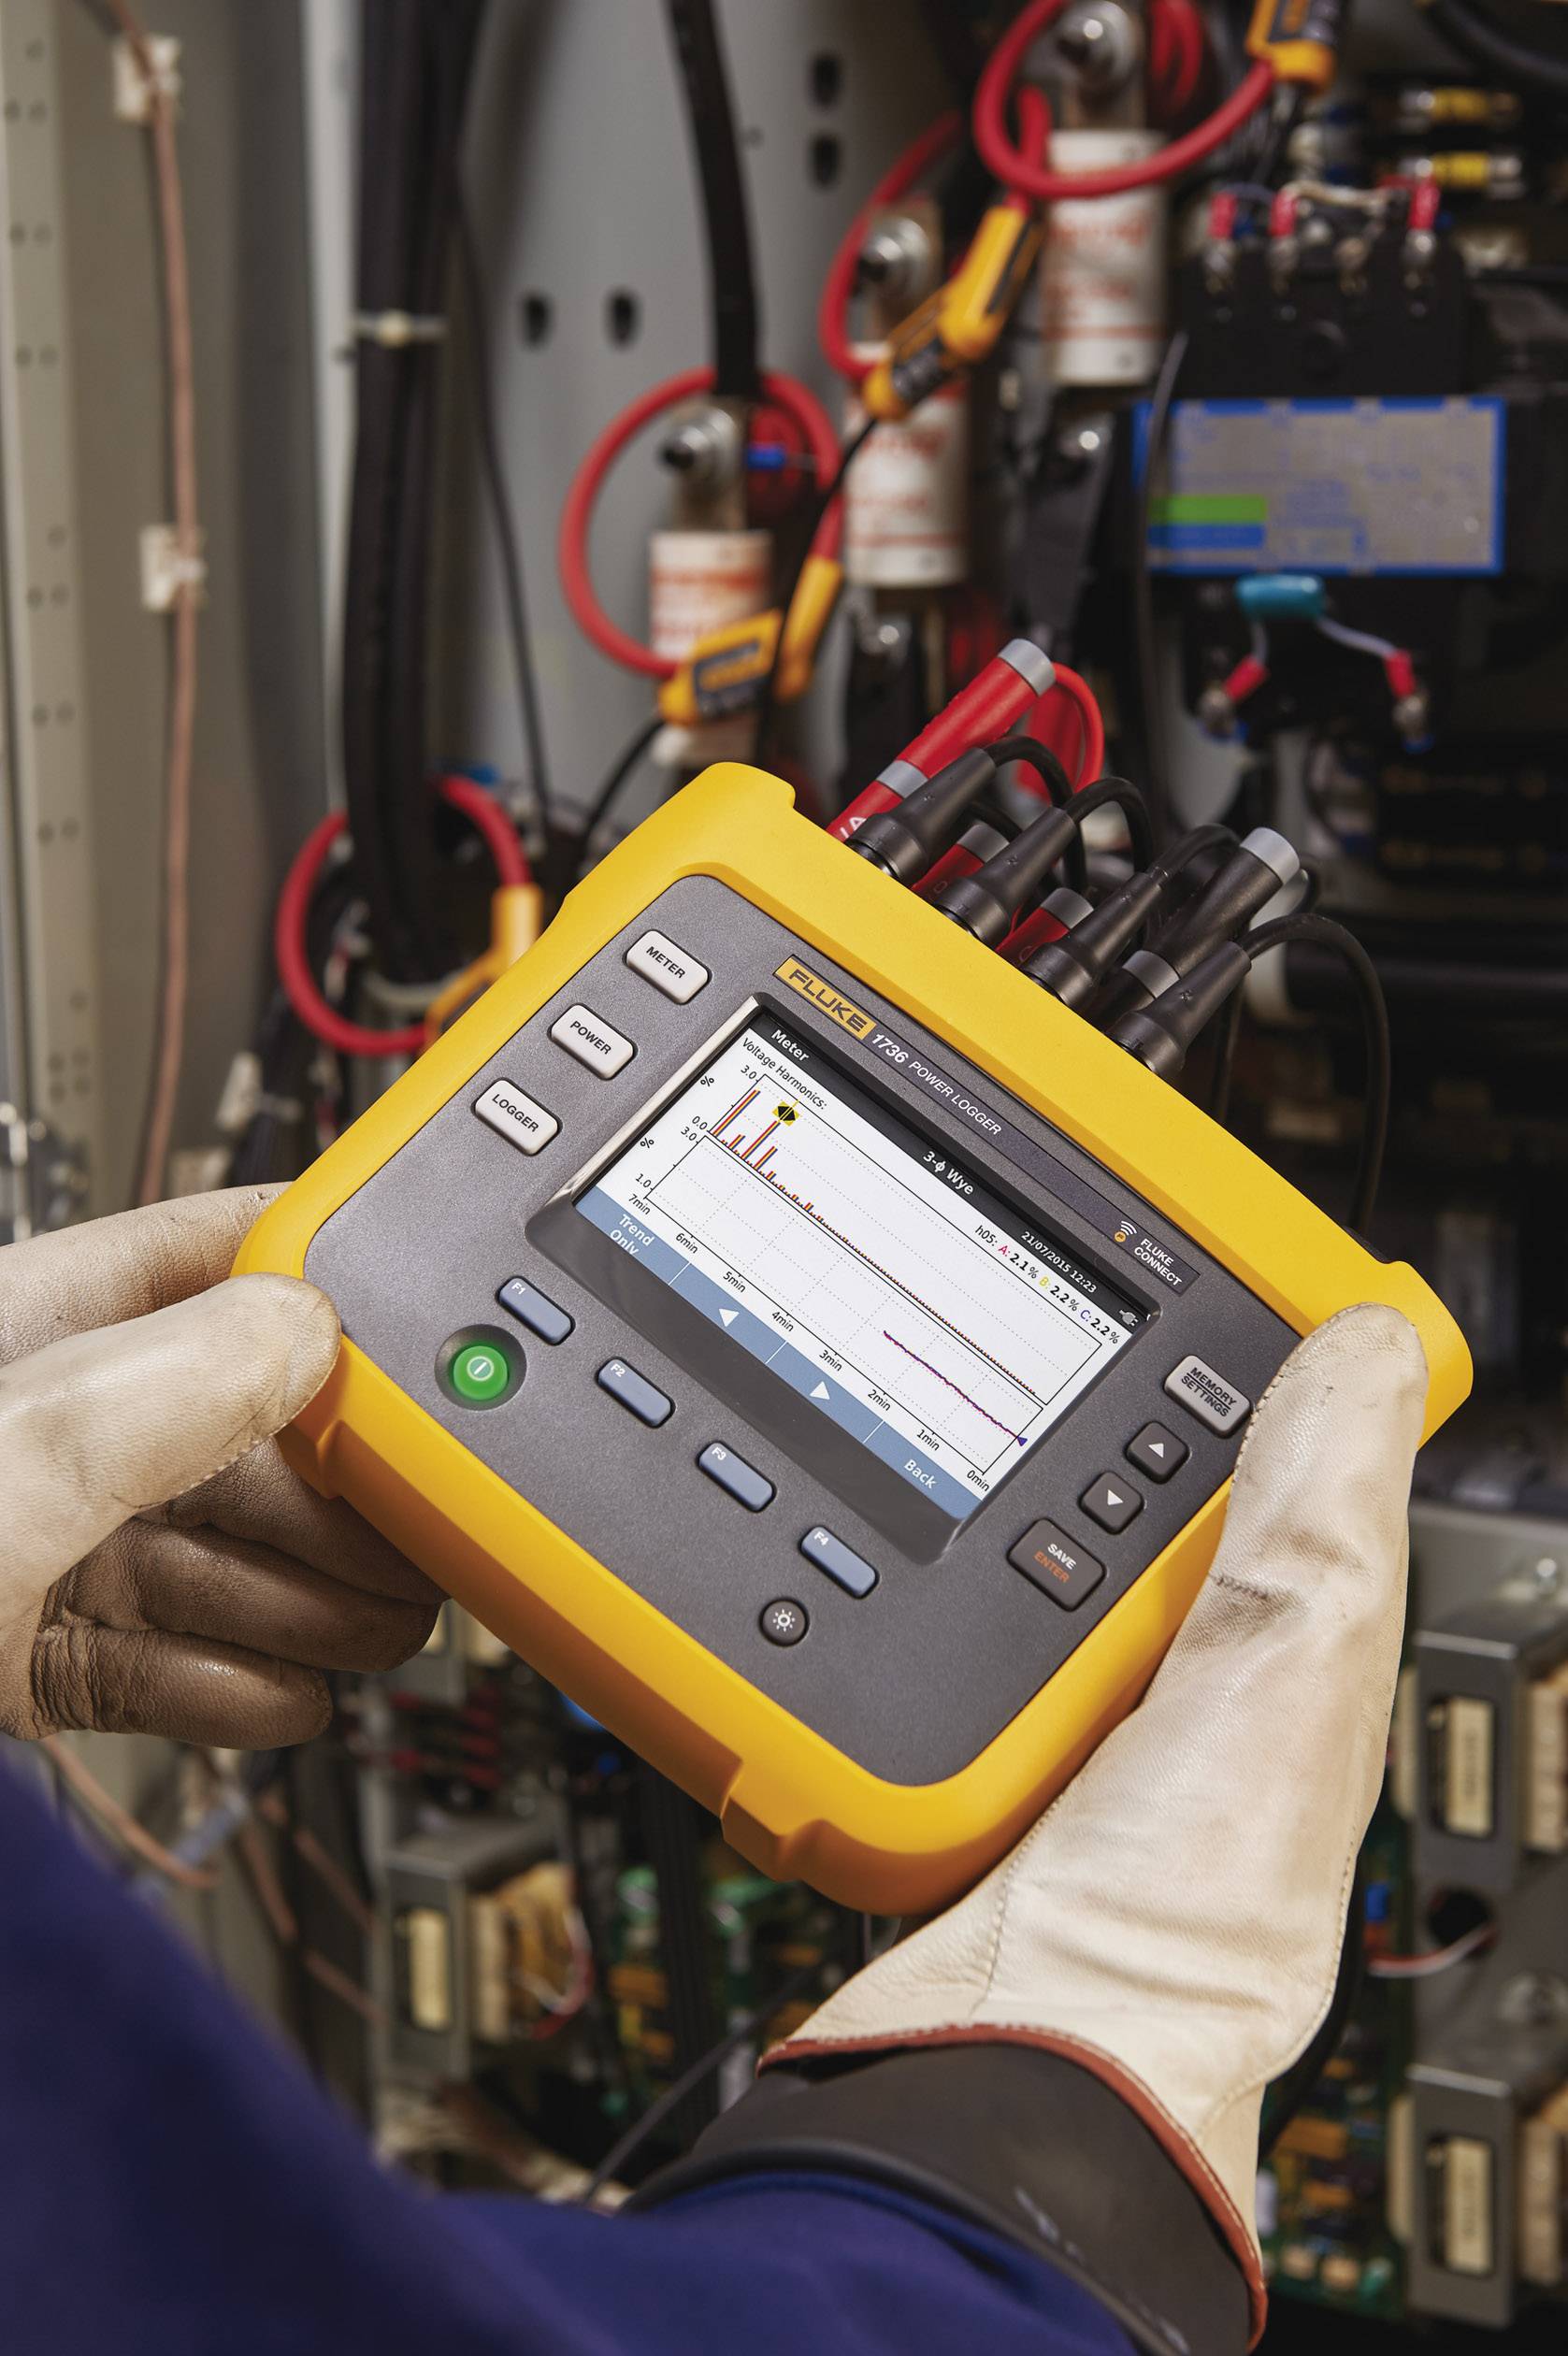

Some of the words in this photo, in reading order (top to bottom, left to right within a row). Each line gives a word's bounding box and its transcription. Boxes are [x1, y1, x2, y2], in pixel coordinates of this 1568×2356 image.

[646, 946, 685, 979] METER
[570, 1021, 611, 1055] POWER
[771, 1029, 810, 1061] Meter
[789, 969, 867, 1032] FLUKE
[871, 1033, 908, 1063] 1736
[908, 1061, 954, 1097] POWER
[952, 1095, 1001, 1135] LOGGER
[700, 1076, 714, 1086] %
[741, 1065, 756, 1080] 3.0
[742, 1038, 776, 1070] Voltage
[776, 1066, 827, 1110] Harmonics:
[492, 1094, 539, 1132] LOGGER
[691, 1115, 708, 1130] 0.0
[640, 1138, 655, 1148] %
[681, 1127, 698, 1142] 3.0
[636, 1173, 652, 1188] 1.0
[947, 1169, 974, 1196] Wye
[628, 1193, 651, 1214] 7min
[610, 1229, 640, 1254] Only
[619, 1214, 655, 1246] Trend
[675, 1233, 698, 1254] 6min
[1141, 1239, 1174, 1267] FLUKE
[1021, 1231, 1072, 1272] 21/07/2015
[1070, 1270, 1097, 1293] 12:23
[1134, 1246, 1182, 1286] CONNECT
[511, 1283, 525, 1295] F1
[723, 1271, 746, 1293] 5min
[974, 1225, 998, 1247] h05:
[999, 1245, 1011, 1257] A:
[1010, 1254, 1029, 1271] 2.1
[1029, 1267, 1039, 1279] %
[1050, 1286, 1070, 1303] 2.2
[1069, 1300, 1079, 1312] %
[1080, 1310, 1092, 1322] C:
[1090, 1318, 1110, 1336] 2.2
[1109, 1332, 1120, 1344] %
[771, 1311, 794, 1332] 4min
[611, 1364, 625, 1377] F2
[819, 1350, 842, 1372] 3min
[1181, 1375, 1229, 1417] SETTINGS
[1190, 1368, 1237, 1406] MEMORY
[868, 1389, 891, 1411] 2min
[916, 1429, 940, 1451] 1min
[712, 1447, 726, 1460] F3
[904, 1459, 937, 1488] Back
[967, 1470, 990, 1491] 0min
[813, 1531, 829, 1545] F4
[1034, 1551, 1070, 1583] ENTER
[1048, 1544, 1076, 1570] SAVE
